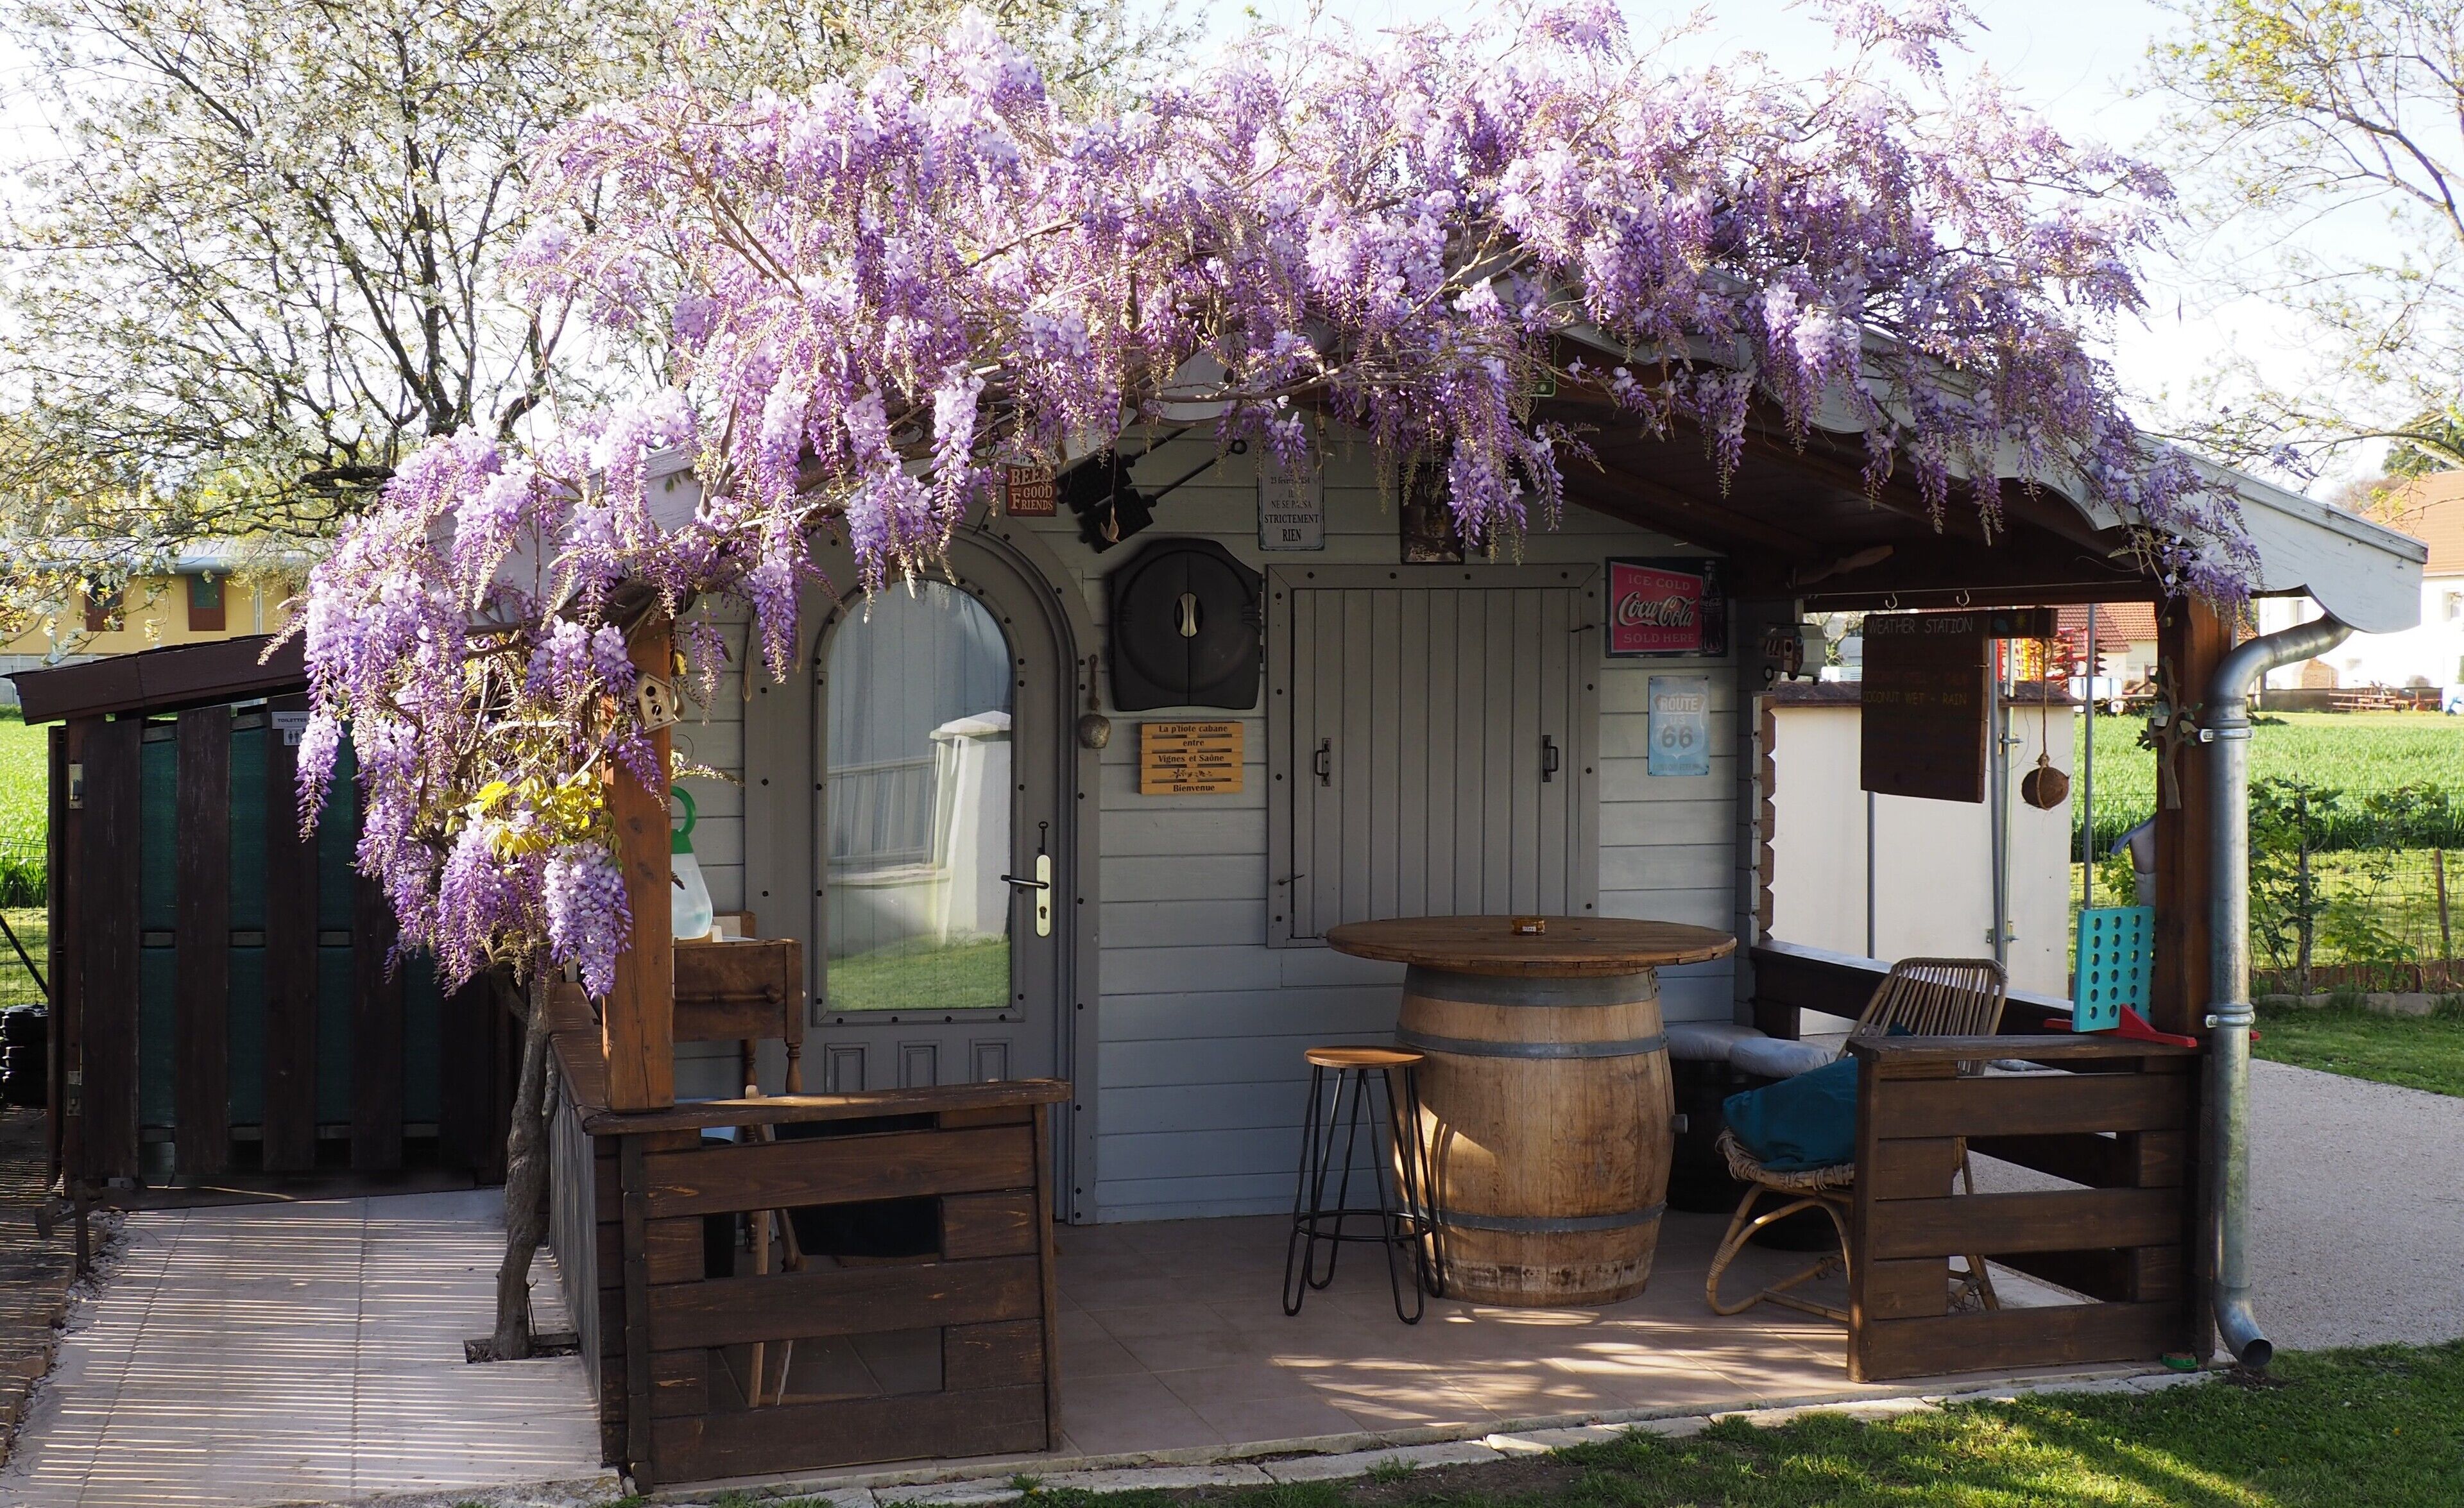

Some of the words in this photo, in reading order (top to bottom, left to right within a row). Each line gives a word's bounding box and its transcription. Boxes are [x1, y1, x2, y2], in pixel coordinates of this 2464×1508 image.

[1023, 486, 1052, 498] GOOD
[1288, 490, 1294, 498] IL
[1011, 493, 1052, 510] FRIENDS
[1272, 501, 1279, 509] NE
[1282, 501, 1290, 509] SE
[1264, 515, 1319, 523] STRICTEMENT
[1283, 529, 1301, 542] RIEN
[1629, 575, 1652, 585] ICE
[1656, 578, 1691, 590] COLD
[1618, 591, 1696, 628] Coca-Cola
[1869, 618, 1915, 634] WEATHER
[1925, 617, 1973, 633] STATION
[1624, 634, 1659, 643] SOLD
[1663, 633, 1695, 642] HERE
[1661, 698, 1698, 711] ROUTE
[1863, 692, 1899, 703] COCONUT
[1905, 693, 1925, 704] WET
[1942, 692, 1969, 706] RAIN
[1171, 725, 1196, 733] p'tiote
[1662, 726, 1693, 750] 66
[1158, 755, 1185, 764] Vignes
[1173, 784, 1215, 793] Bienvenue
